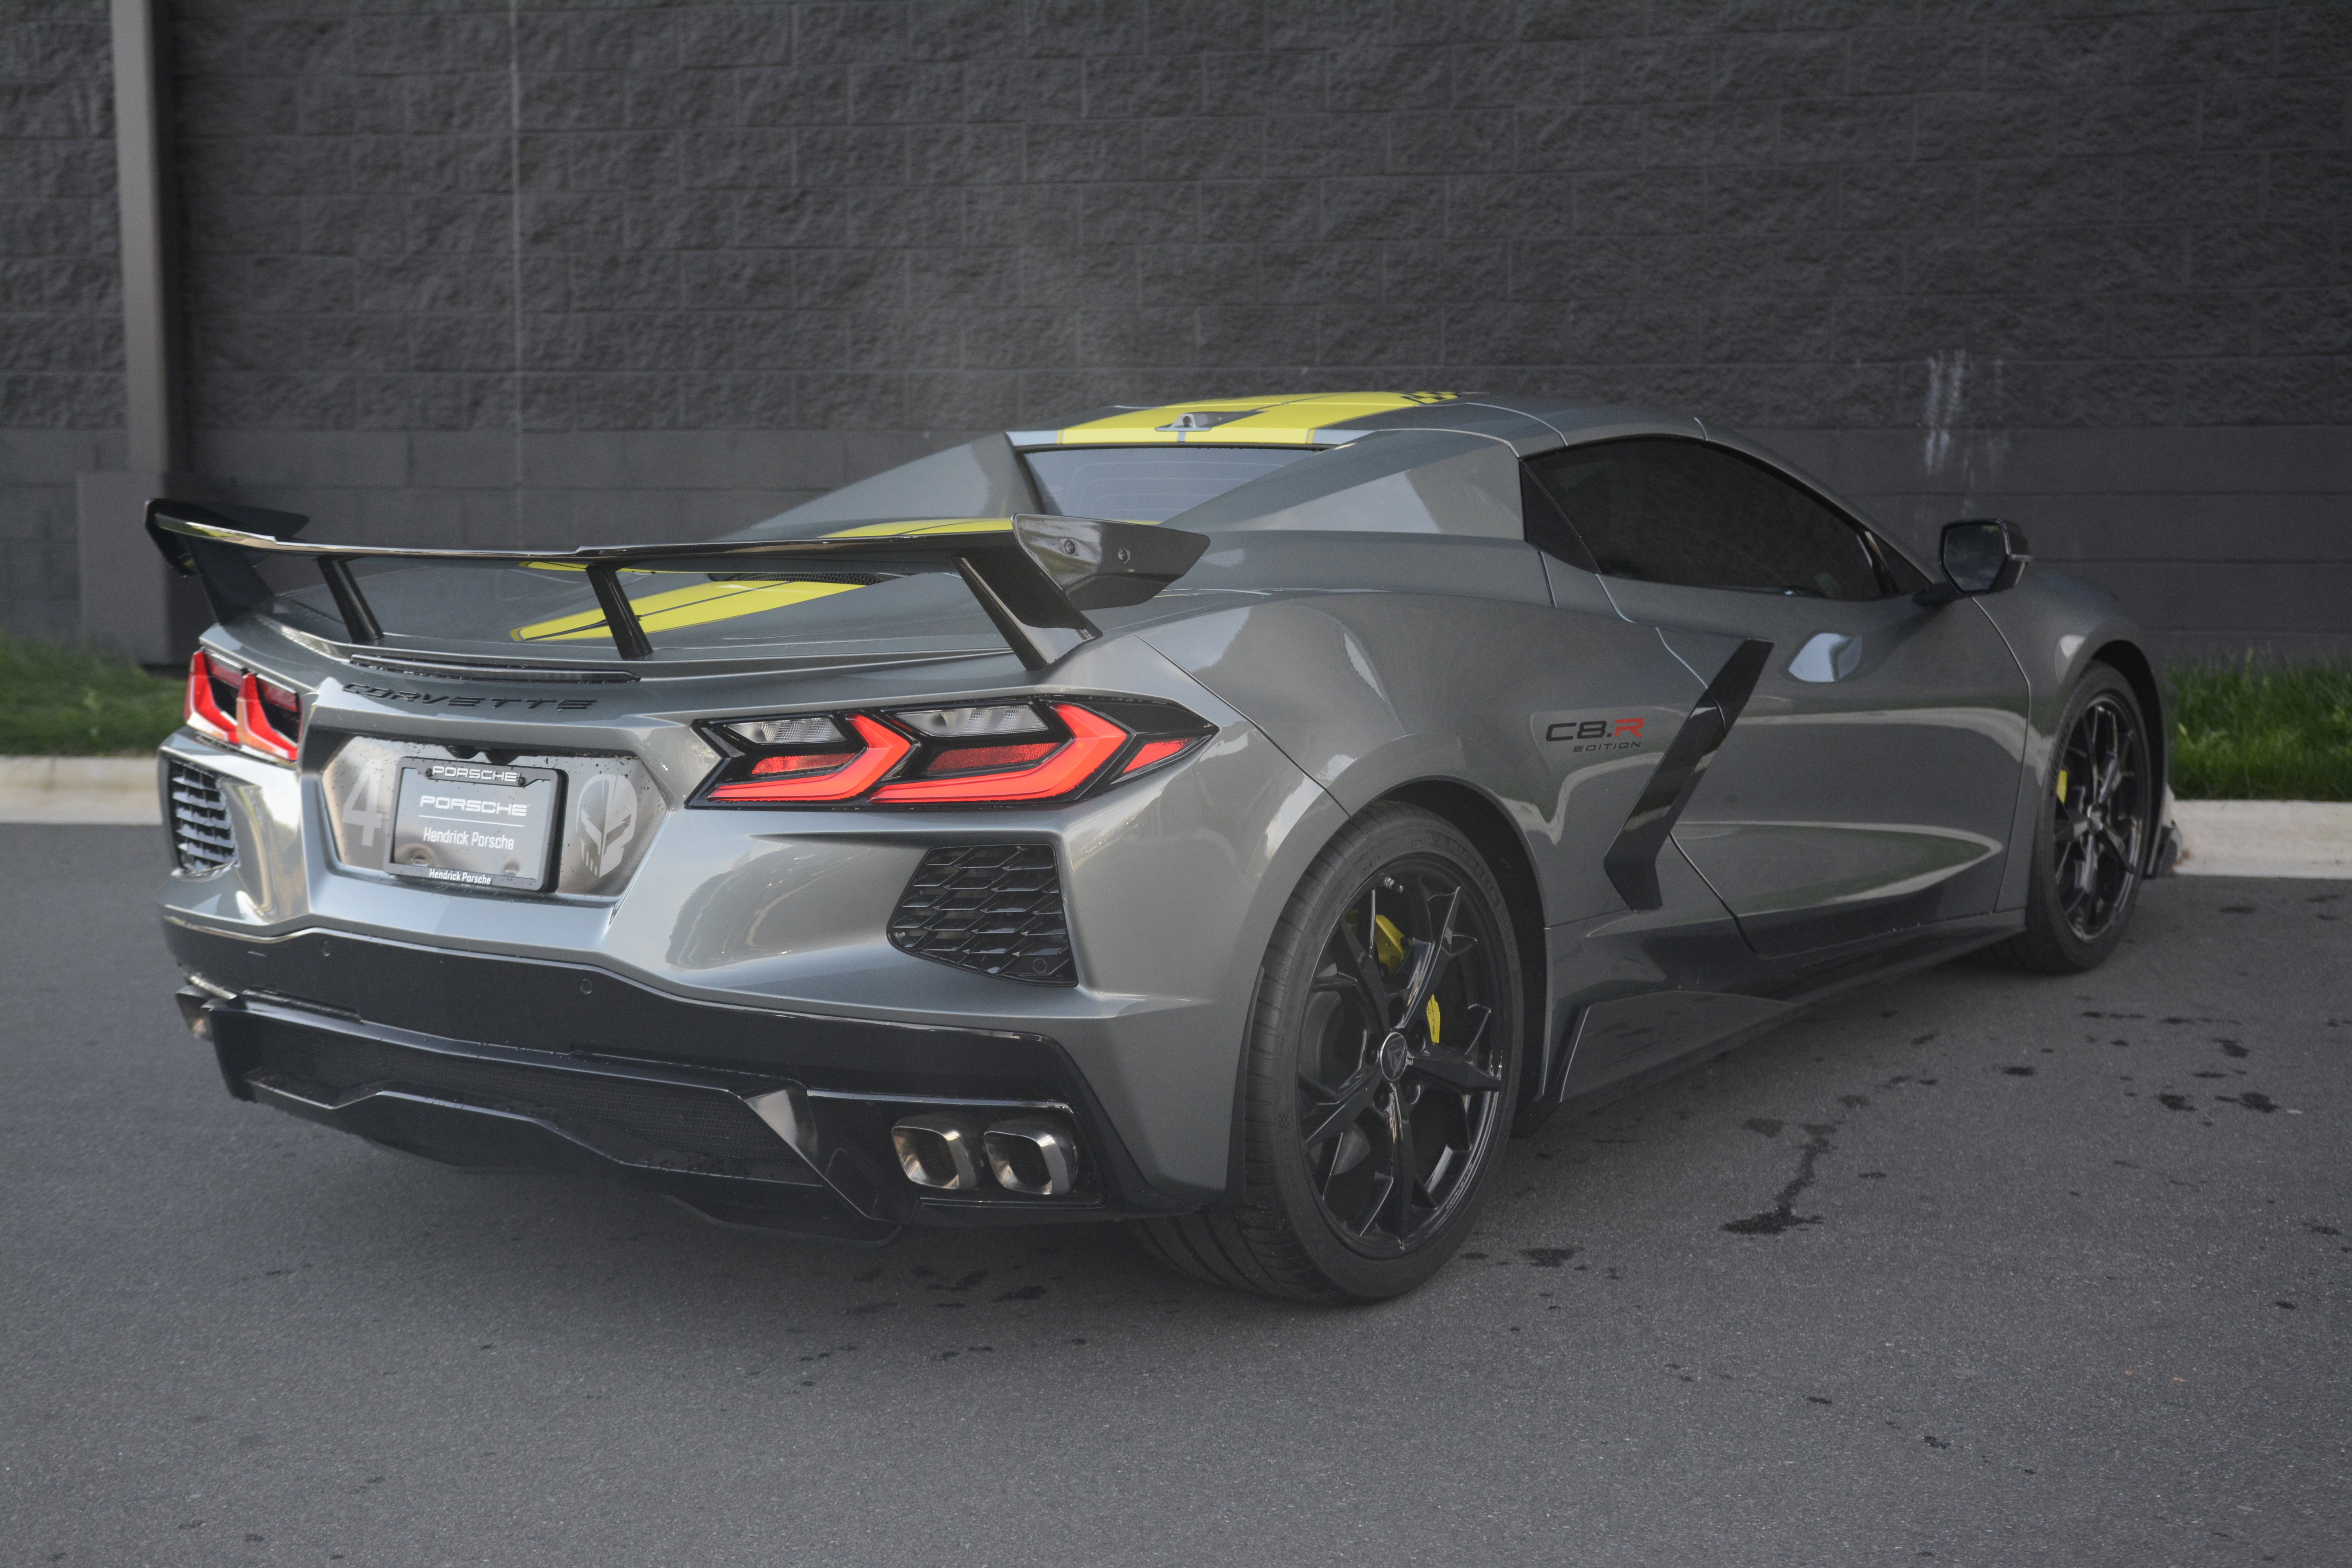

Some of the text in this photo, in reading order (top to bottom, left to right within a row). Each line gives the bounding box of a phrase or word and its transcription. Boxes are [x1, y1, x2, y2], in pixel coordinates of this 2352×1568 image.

[342, 683, 597, 710] CORVETTE
[1546, 717, 1644, 742] C8.R
[1573, 741, 1641, 752] EDITION
[432, 765, 518, 782] PORSCHE
[341, 758, 383, 847] 4
[419, 795, 528, 817] PORSCHE
[423, 826, 515, 851] Hendrick Porsche
[429, 868, 492, 885] Hendrick Porsche
